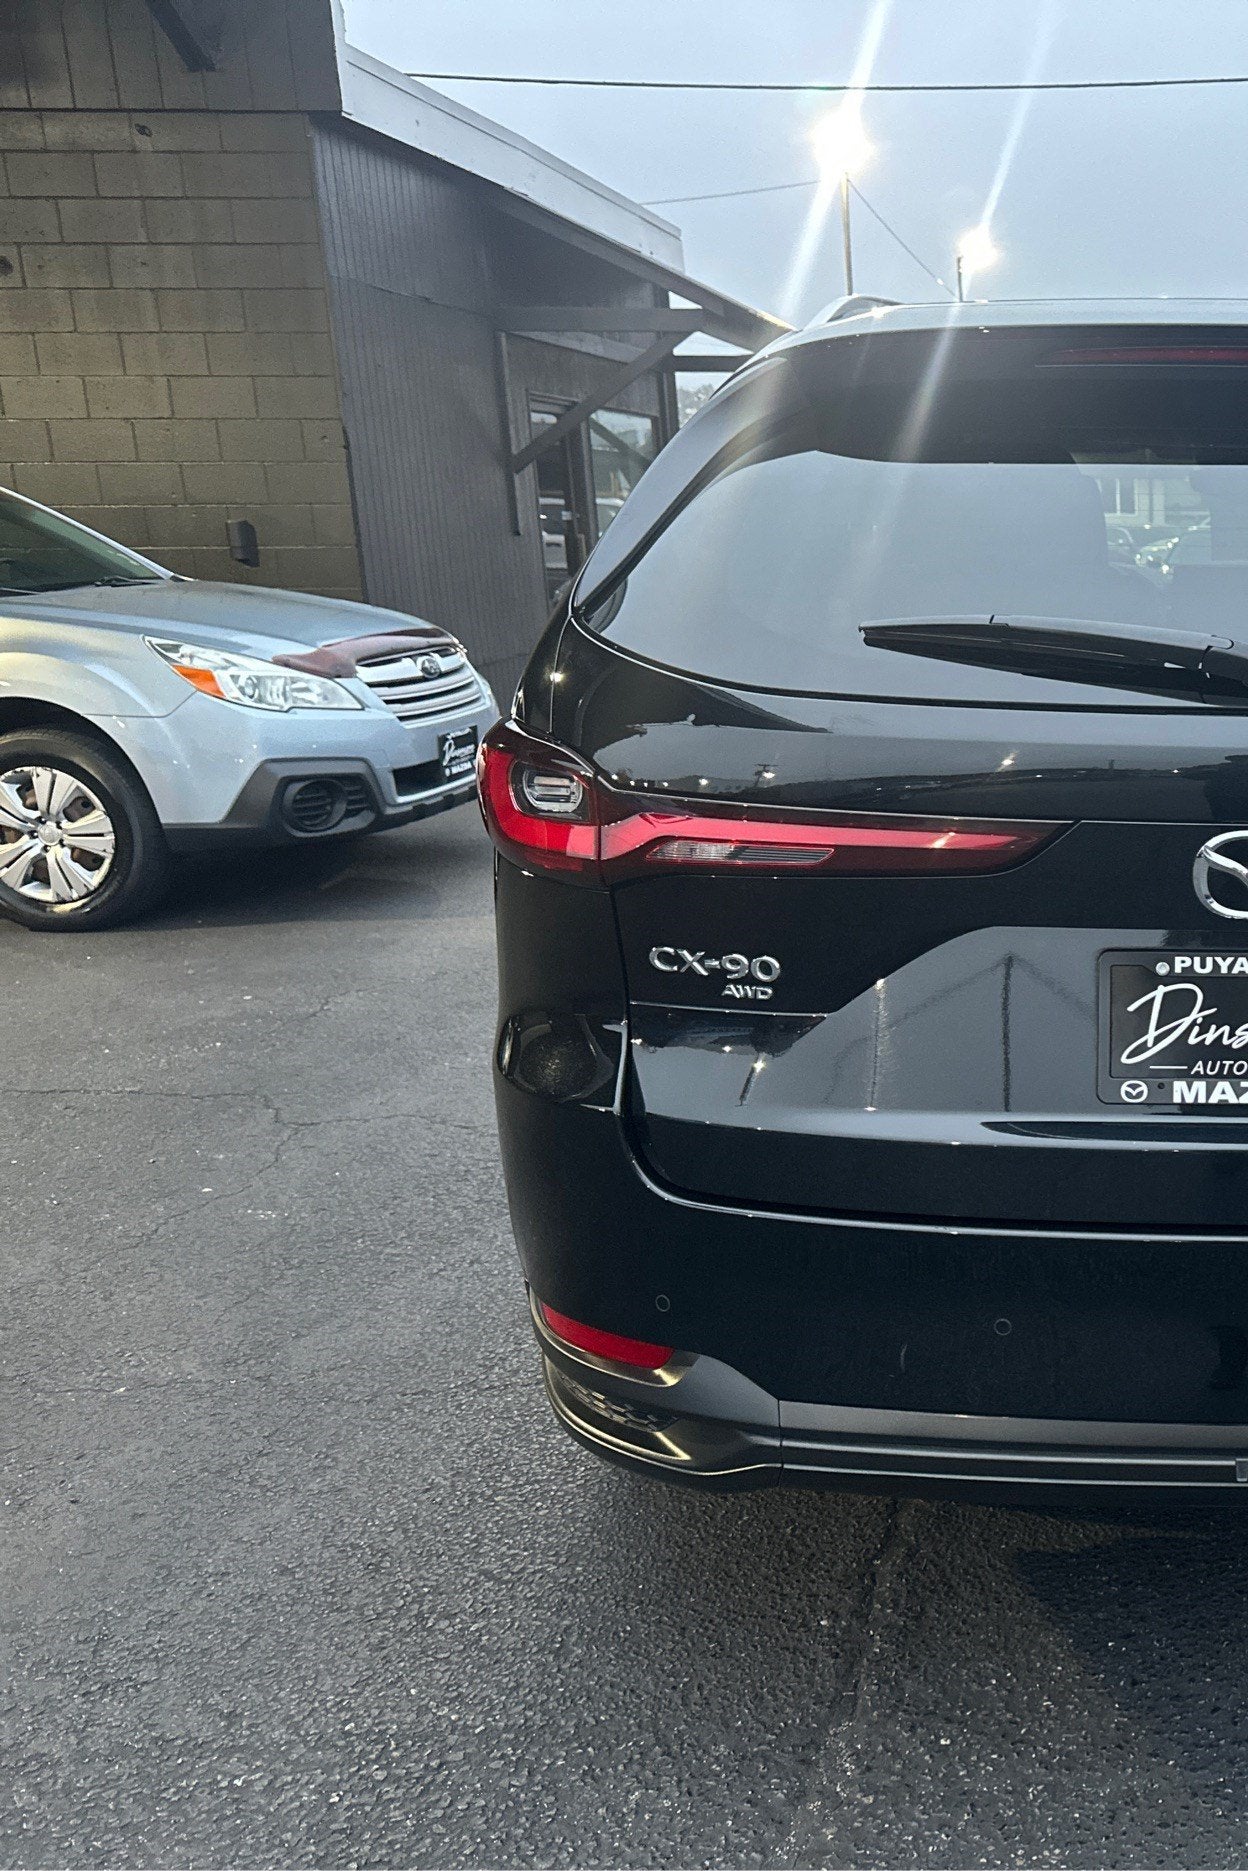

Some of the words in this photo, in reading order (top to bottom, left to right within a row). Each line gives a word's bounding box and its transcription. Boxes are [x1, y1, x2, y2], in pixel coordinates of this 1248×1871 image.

[649, 946, 781, 983] CX-90
[721, 984, 773, 1000] AWD
[1190, 1060, 1248, 1076] AUTO
